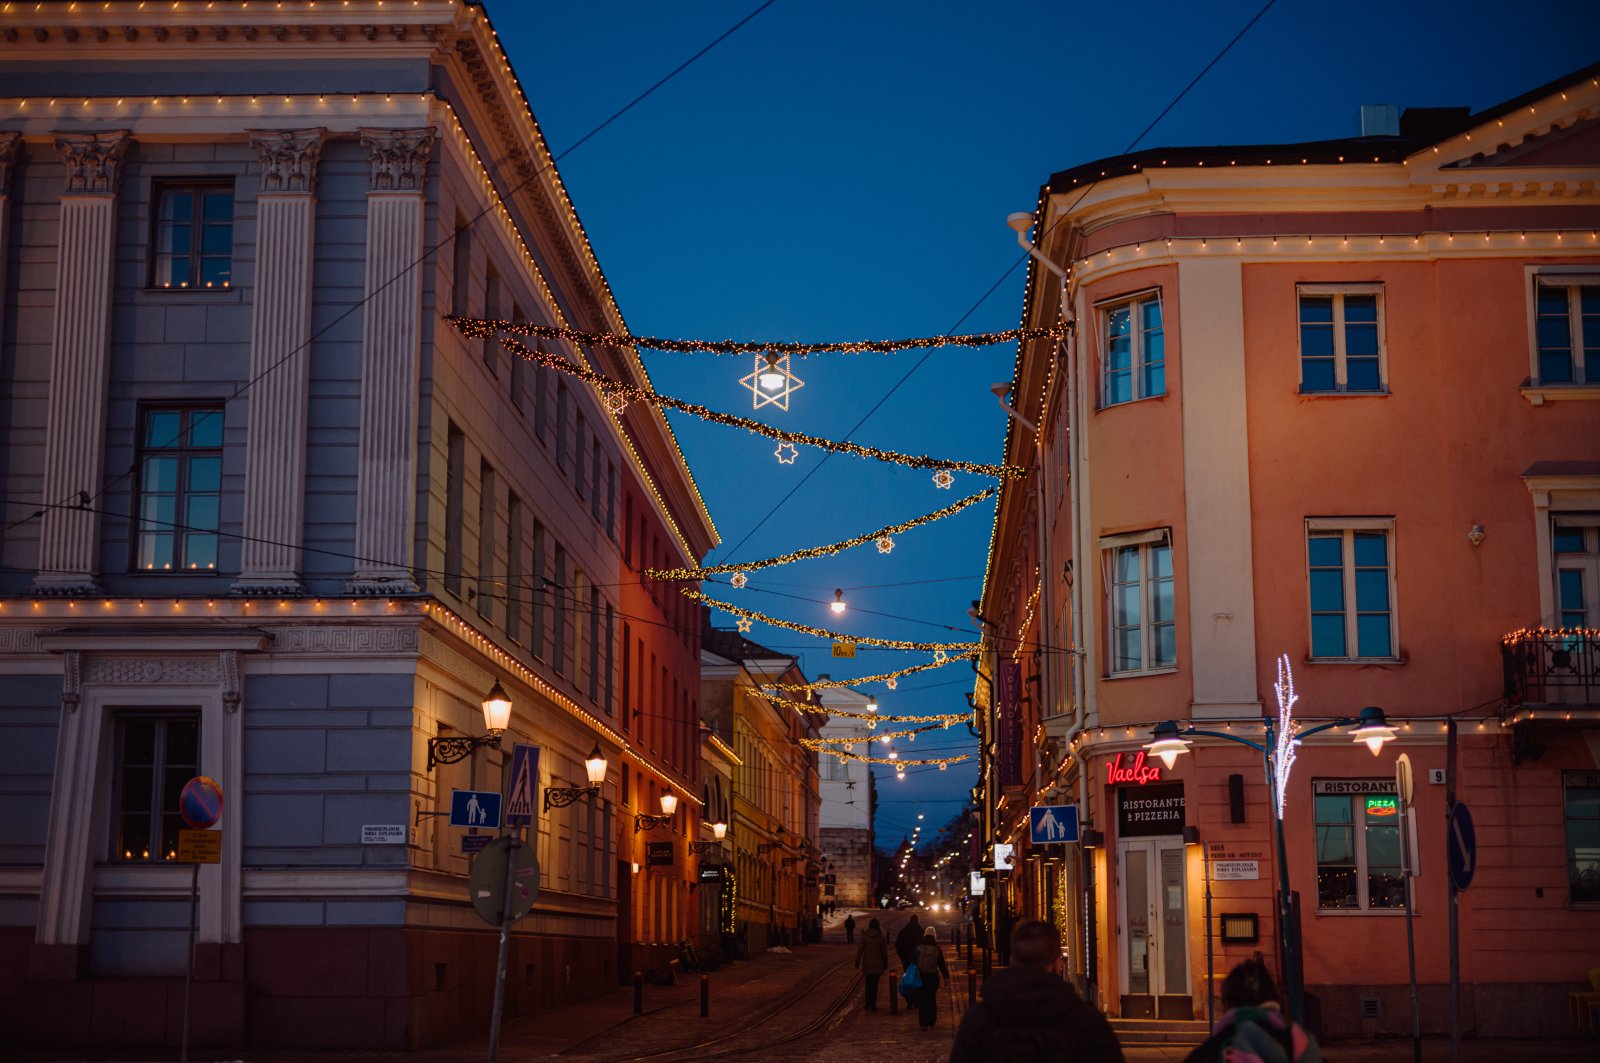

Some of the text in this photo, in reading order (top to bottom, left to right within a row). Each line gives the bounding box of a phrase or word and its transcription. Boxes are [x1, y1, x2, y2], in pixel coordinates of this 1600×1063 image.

[1106, 752, 1160, 785] Vaelsa
[1436, 770, 1442, 782] 9
[1586, 776, 1600, 784] PI
[1325, 782, 1398, 792] RISTORANT
[1123, 798, 1186, 810] RISTORANTE
[1368, 800, 1396, 808] PIZZA
[1134, 810, 1180, 822] PIZZERIA
